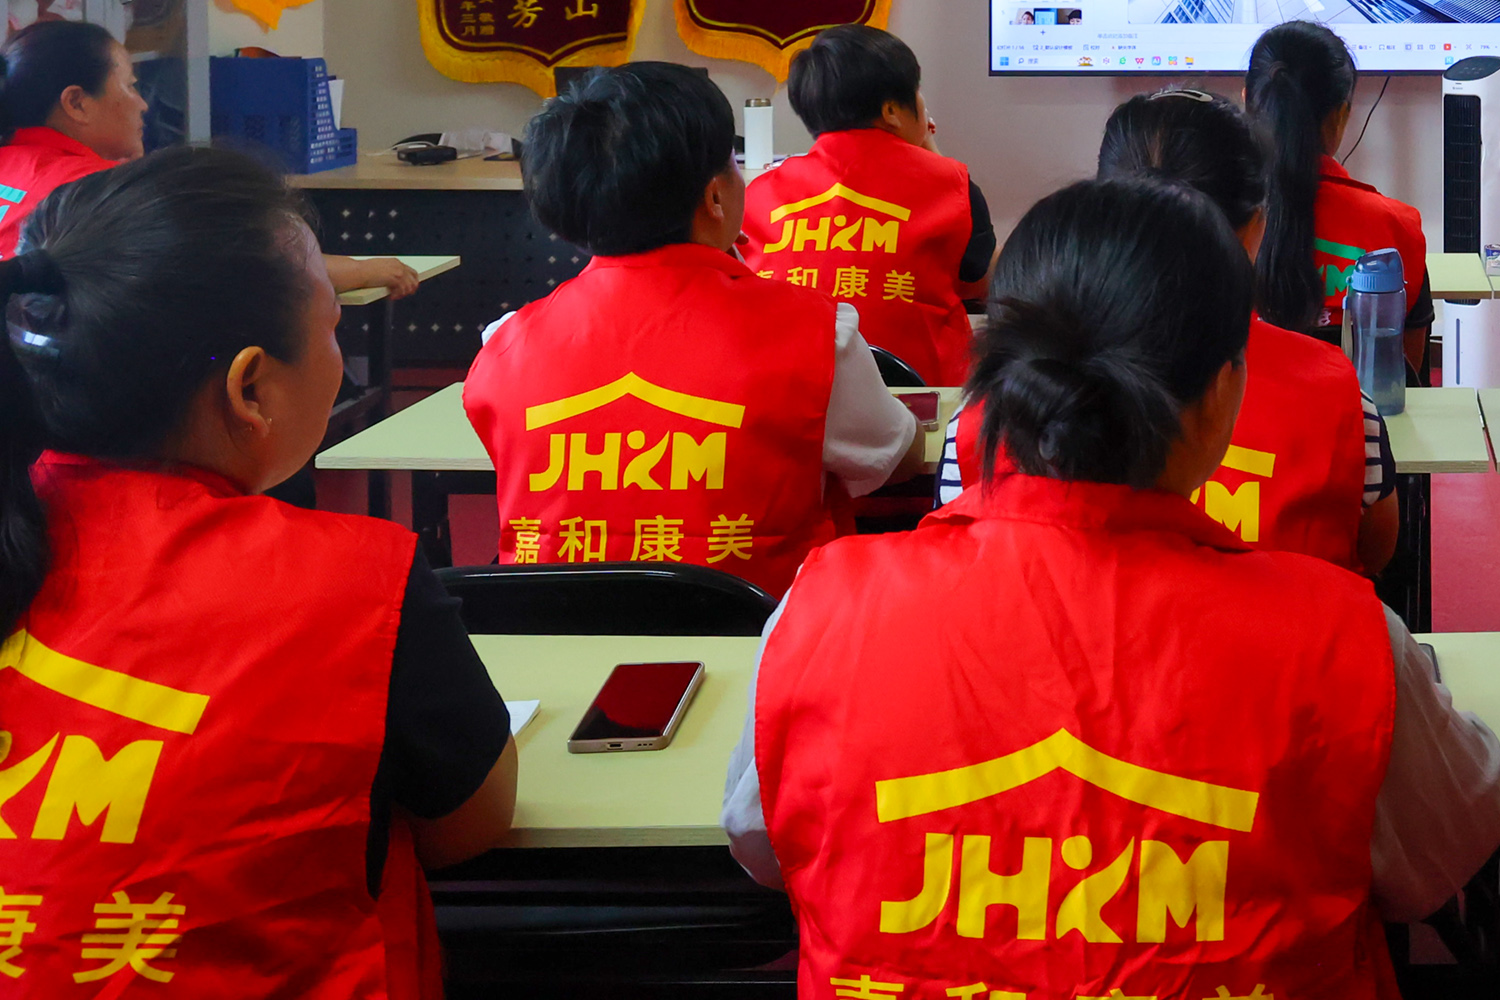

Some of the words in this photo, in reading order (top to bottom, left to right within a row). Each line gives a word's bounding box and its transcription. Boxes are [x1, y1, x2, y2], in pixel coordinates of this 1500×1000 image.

[764, 215, 900, 254] JHKM
[529, 430, 727, 492] JHKM
[508, 513, 755, 564] 嘉和康美
[879, 832, 1230, 944] JHKM
